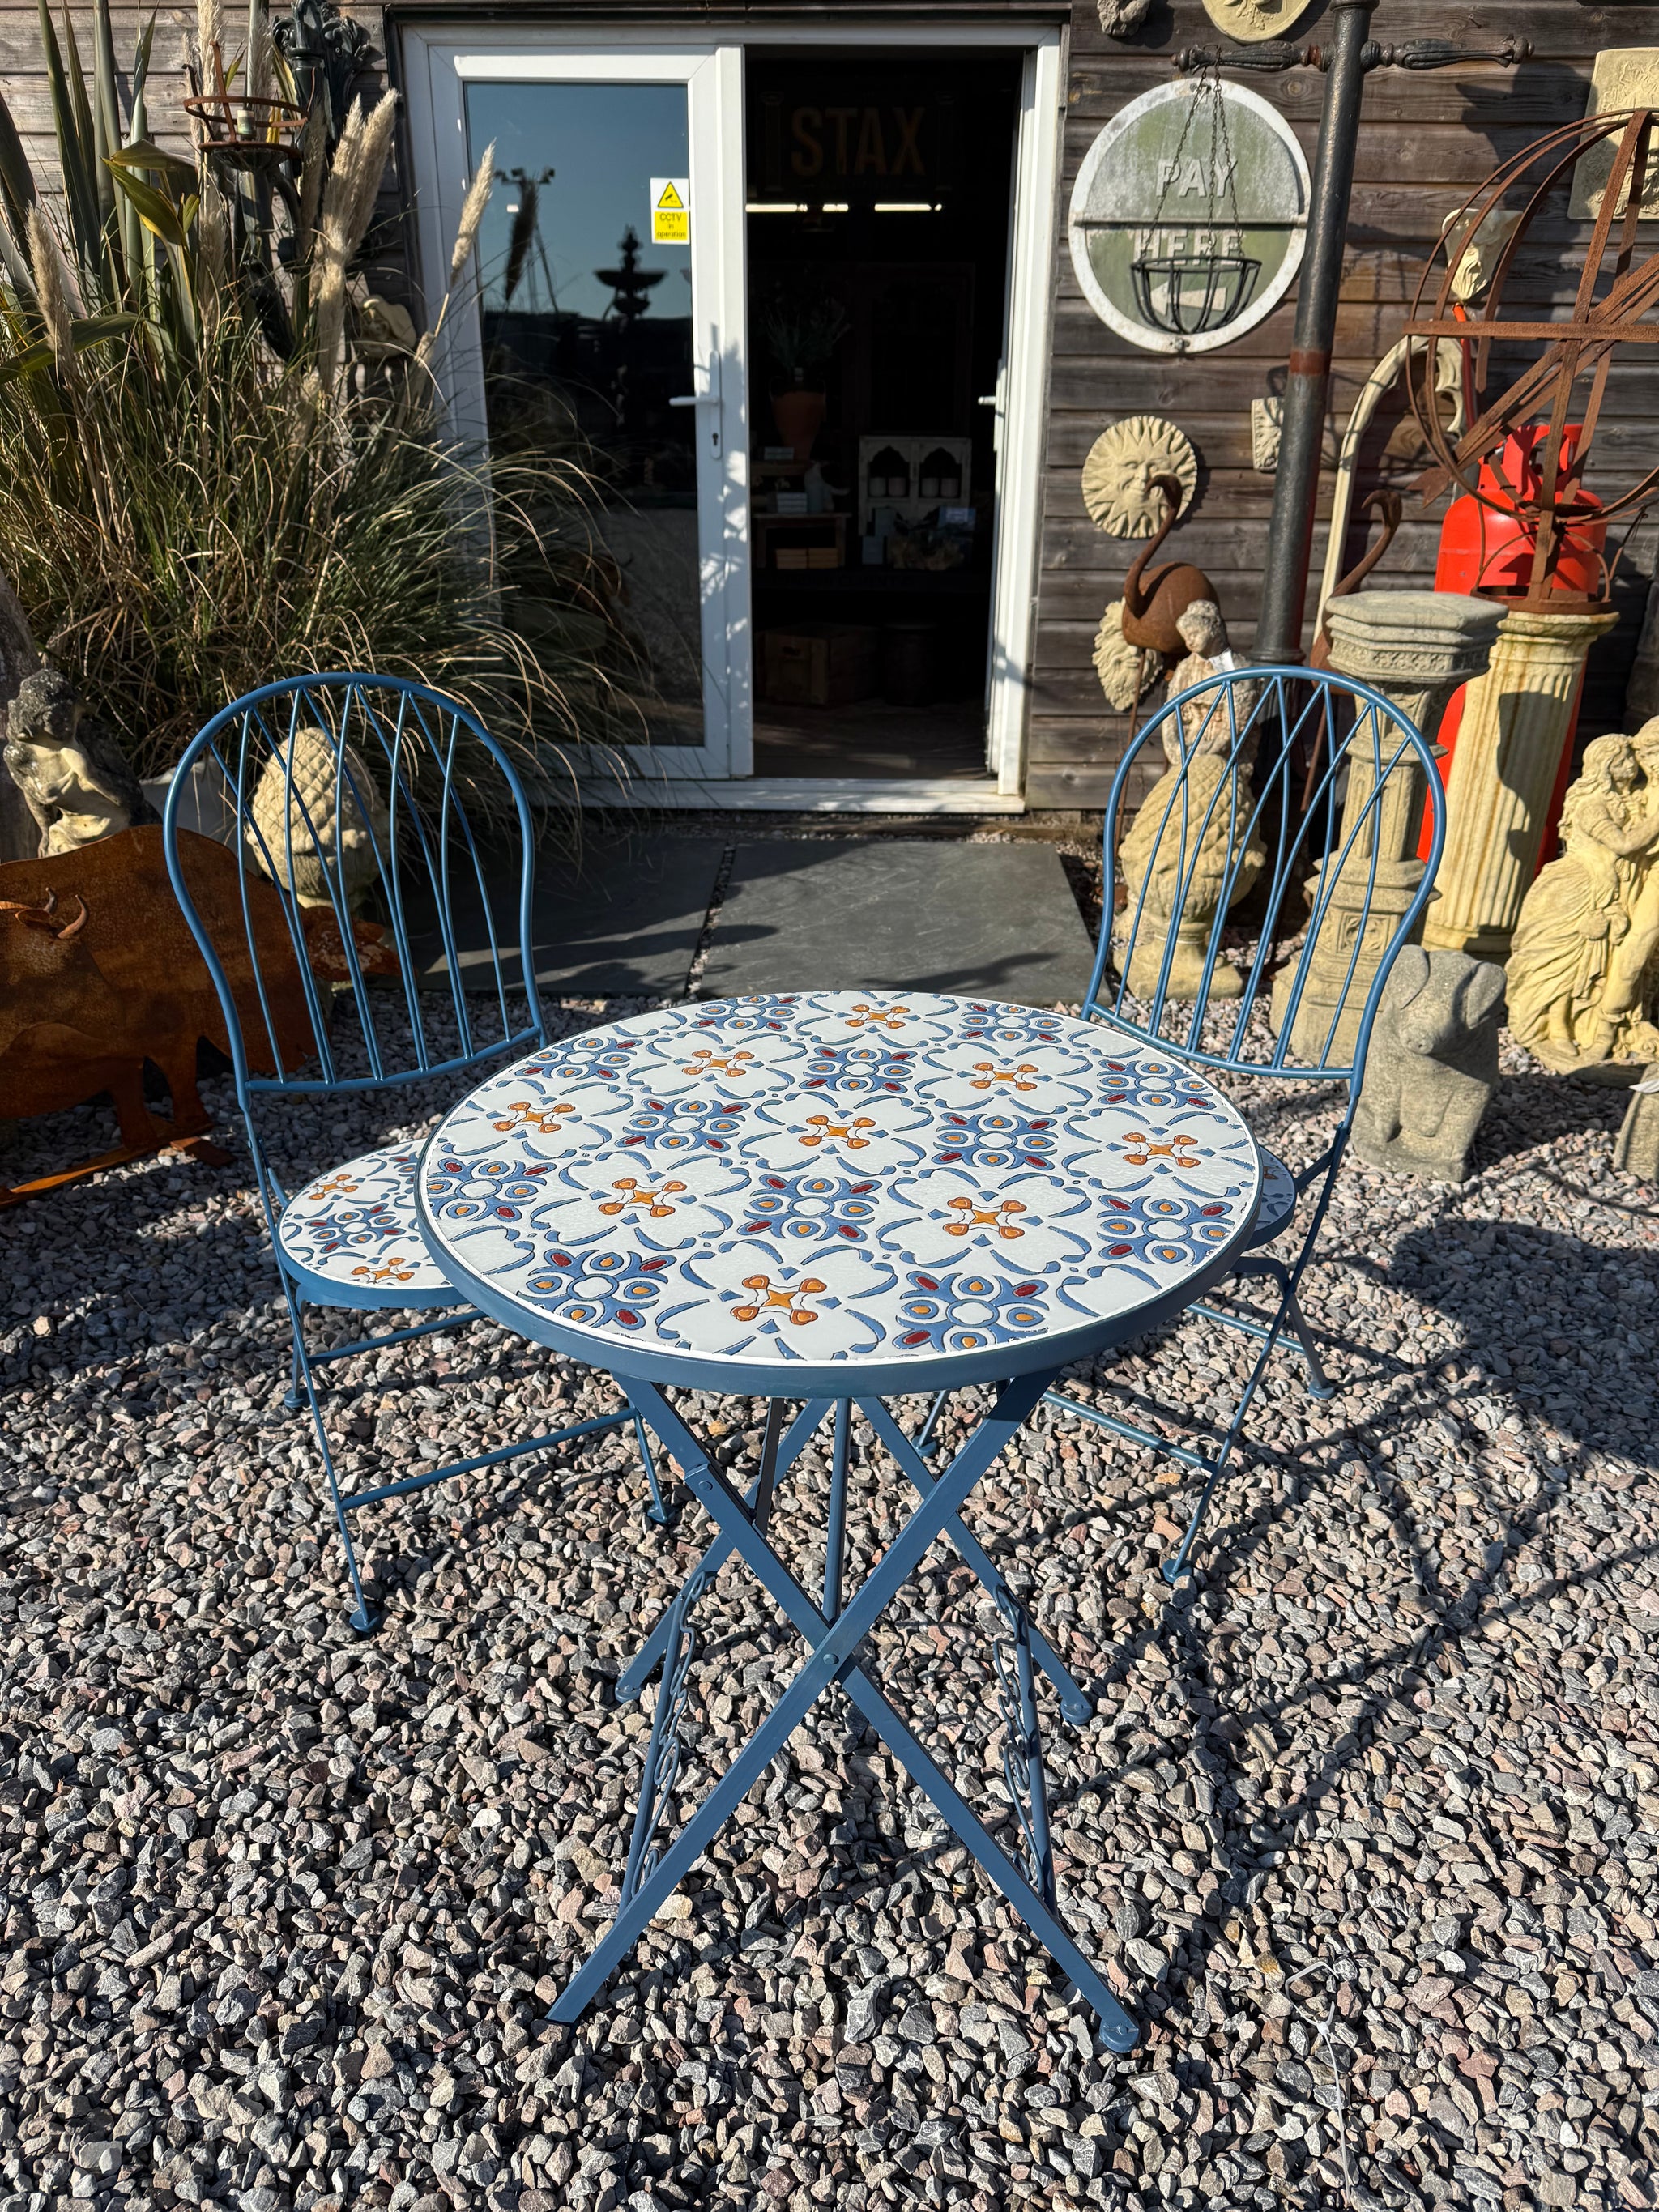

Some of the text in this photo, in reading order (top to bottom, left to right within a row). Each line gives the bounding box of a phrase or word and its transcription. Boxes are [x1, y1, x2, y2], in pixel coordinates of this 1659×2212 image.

[791, 106, 927, 177] STAX
[1156, 159, 1238, 198] PAY
[659, 212, 682, 221] CCTV
[1134, 228, 1244, 266] HERE
